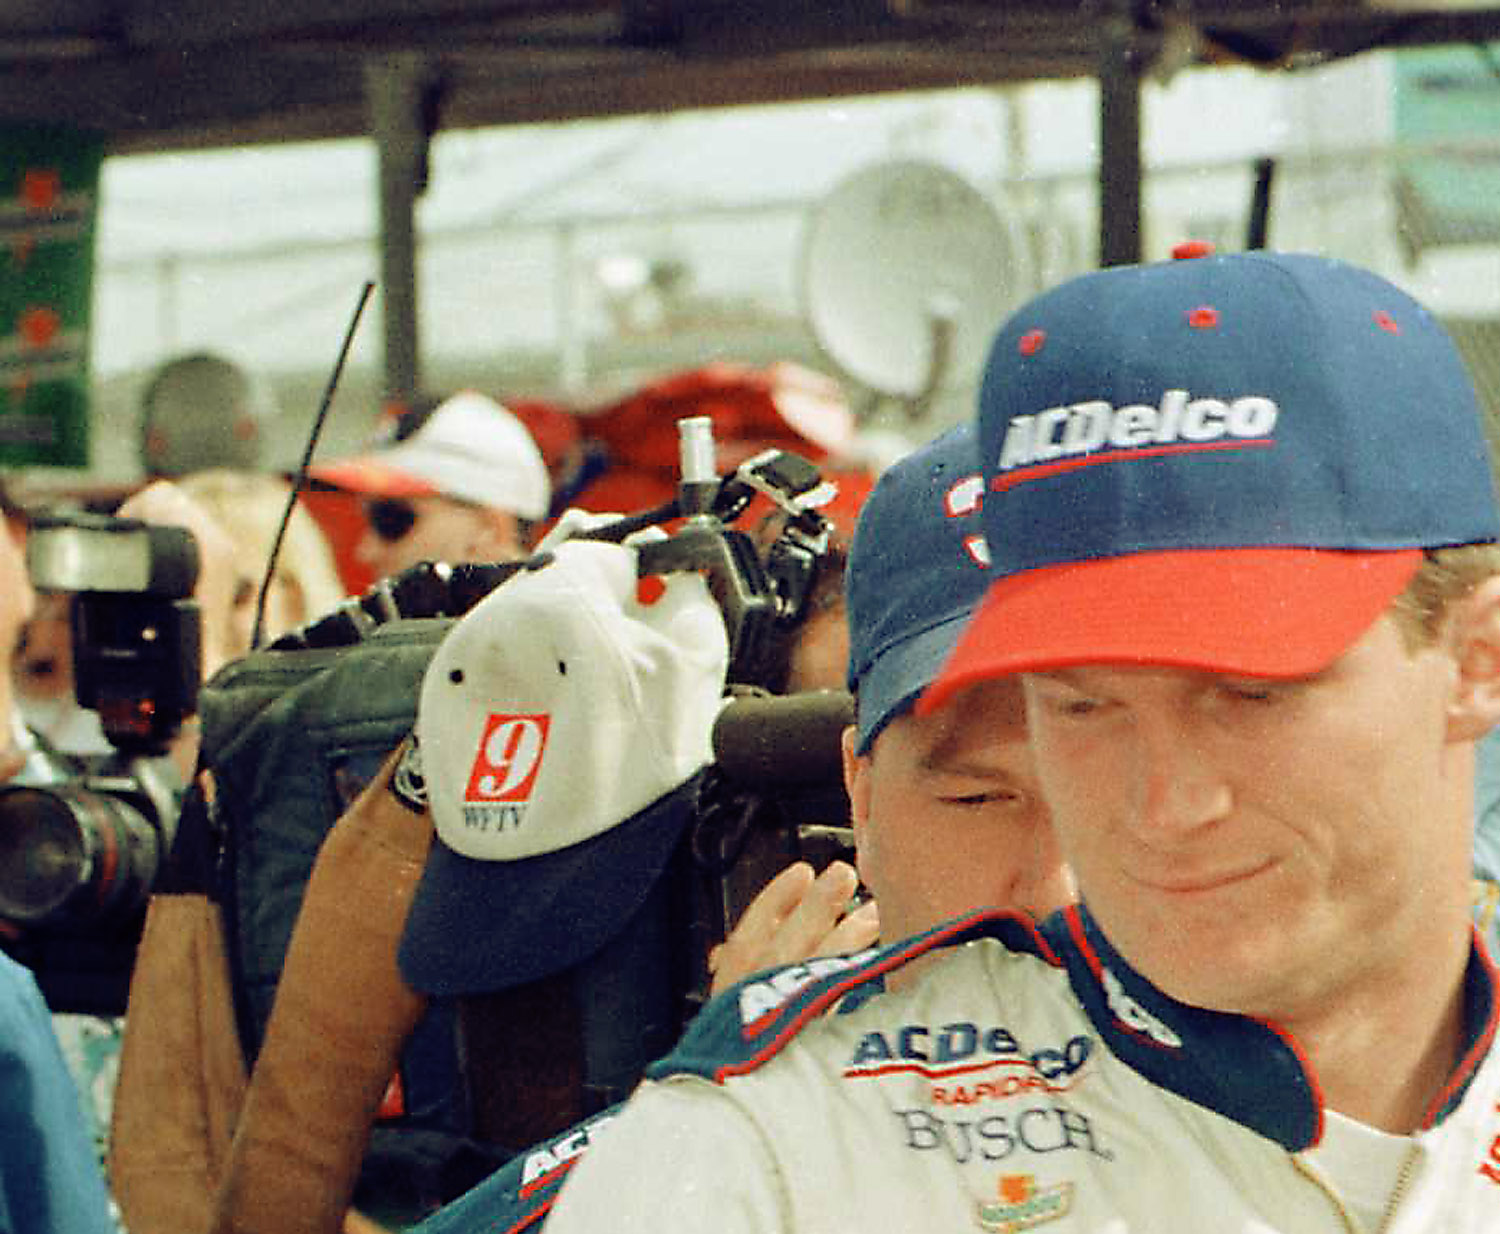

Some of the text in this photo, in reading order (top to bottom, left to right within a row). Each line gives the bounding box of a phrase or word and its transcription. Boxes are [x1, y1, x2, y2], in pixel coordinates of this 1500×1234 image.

[999, 387, 1278, 470] ACDelco
[479, 719, 543, 798] 9
[852, 1023, 1095, 1080] ACDeco
[891, 1108, 1100, 1163] BUSCH
